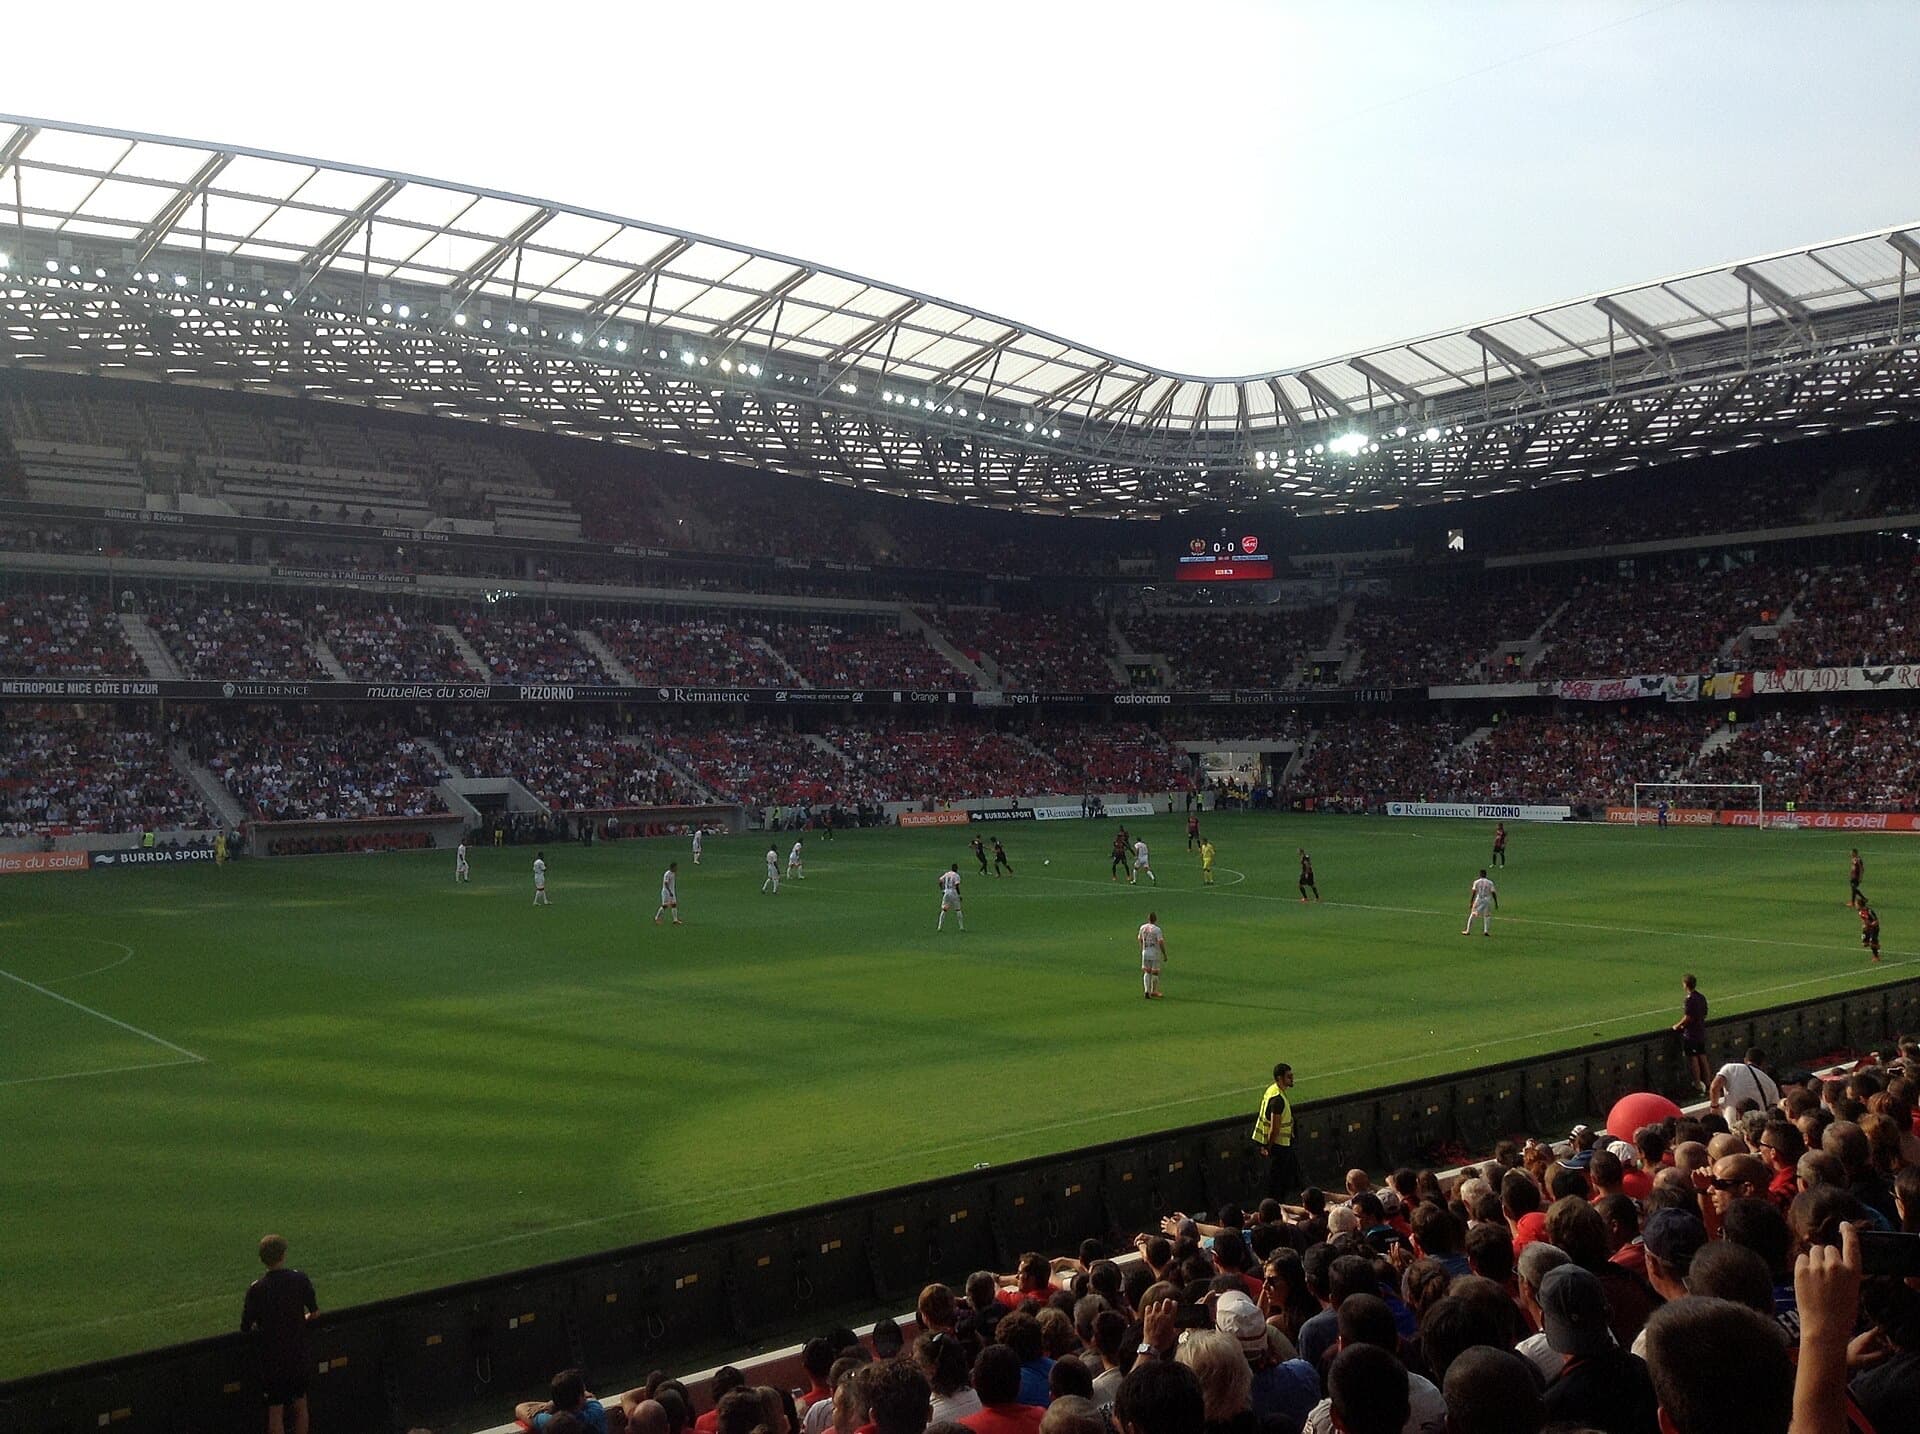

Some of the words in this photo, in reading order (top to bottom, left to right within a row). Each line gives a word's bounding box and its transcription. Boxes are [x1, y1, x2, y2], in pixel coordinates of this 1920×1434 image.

[1213, 543, 1220, 552] 0
[1227, 542, 1234, 552] 0
[67, 682, 91, 694] NICE
[122, 682, 158, 694] D'AZUR
[237, 686, 264, 695] VILLE
[267, 686, 281, 695] DE
[283, 686, 308, 696] NICE
[367, 686, 433, 698] mutuelles
[436, 686, 455, 698] du
[457, 687, 491, 698] soleil
[520, 687, 574, 700] PIZZORNO
[674, 688, 750, 702] Rémanence
[911, 691, 939, 703] Orange
[1114, 694, 1171, 704] castorama
[1477, 806, 1520, 818] PIZZORNO
[1684, 811, 1713, 823] soleil
[1815, 813, 1839, 828] du
[1842, 814, 1887, 828] soleil
[25, 856, 45, 869] du
[48, 855, 84, 868] soleil
[120, 851, 172, 864] BURRDA
[175, 849, 215, 861] SPORT
